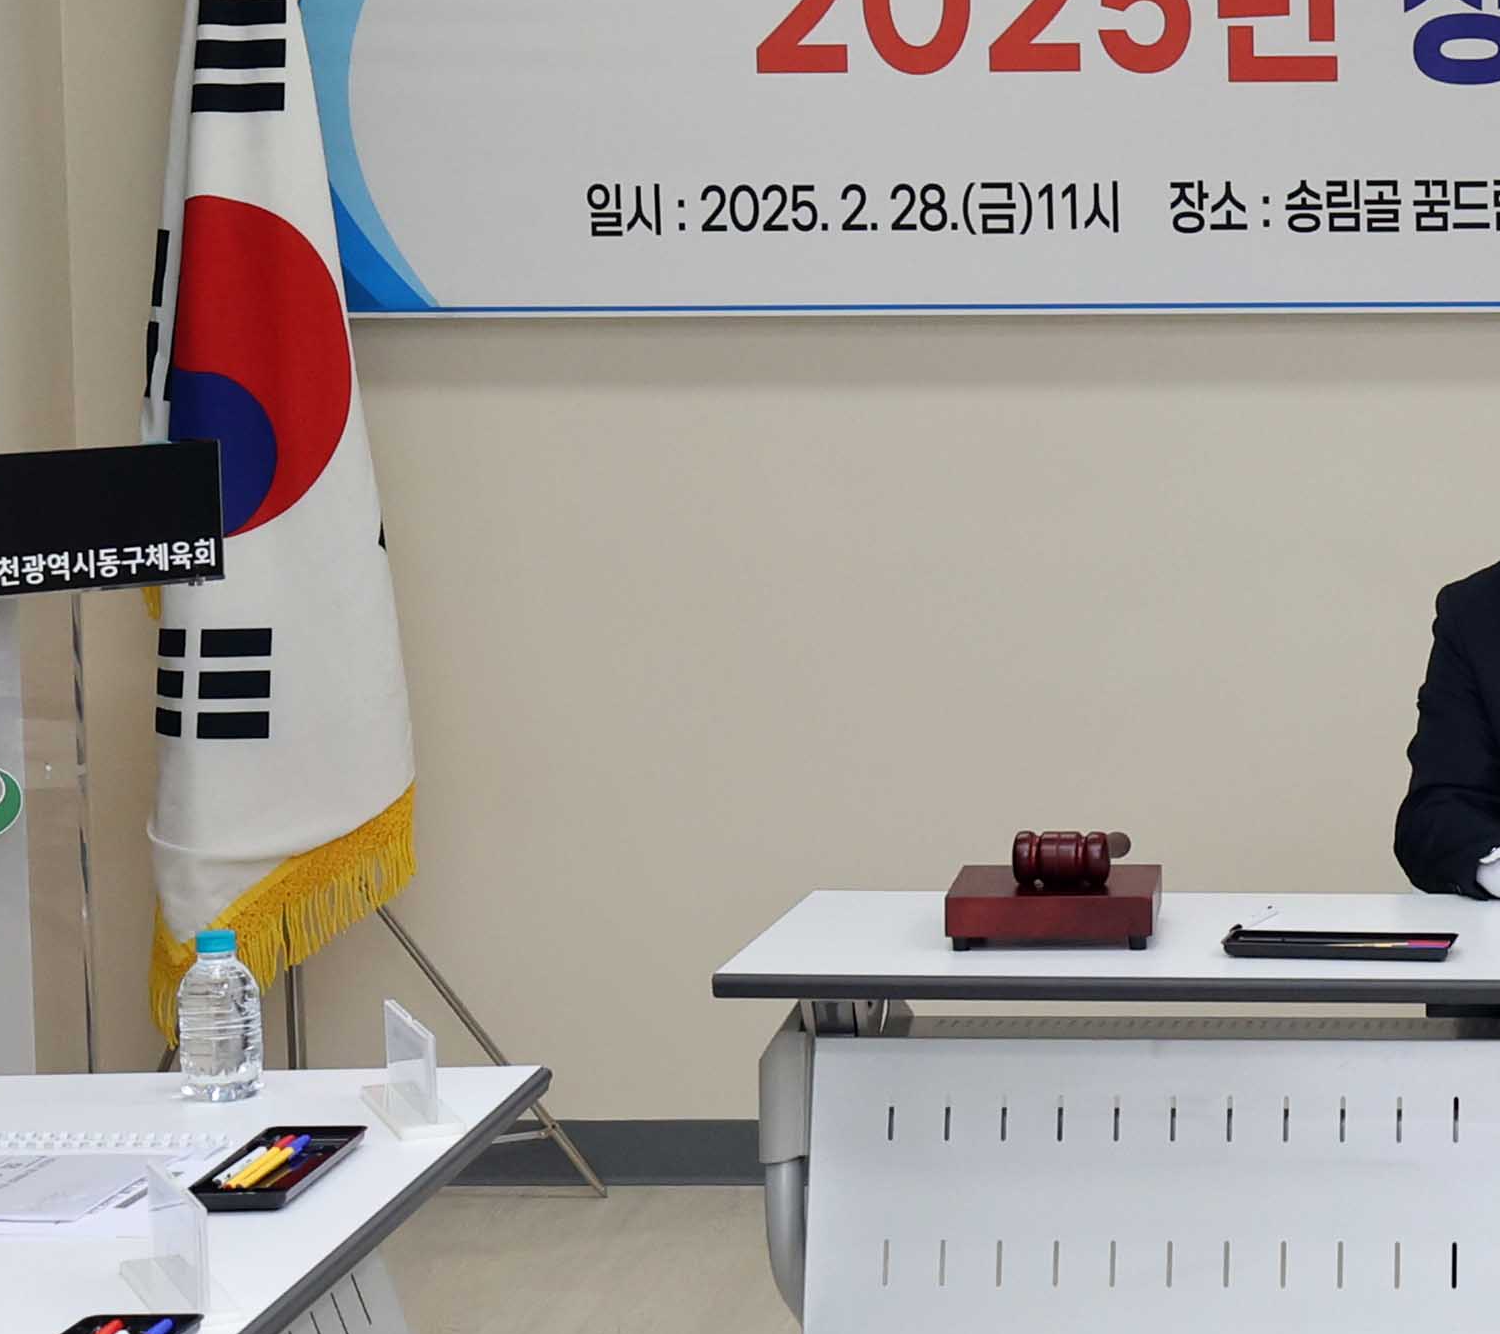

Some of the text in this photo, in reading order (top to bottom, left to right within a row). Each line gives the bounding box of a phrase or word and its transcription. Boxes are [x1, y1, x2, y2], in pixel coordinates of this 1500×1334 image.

[586, 183, 662, 237] 일시
[700, 184, 829, 233] 2025.
[840, 183, 878, 232] 2.
[890, 179, 1120, 236] 28.(금)11시
[1169, 179, 1248, 234] 장소
[1284, 178, 1402, 233] 송림골
